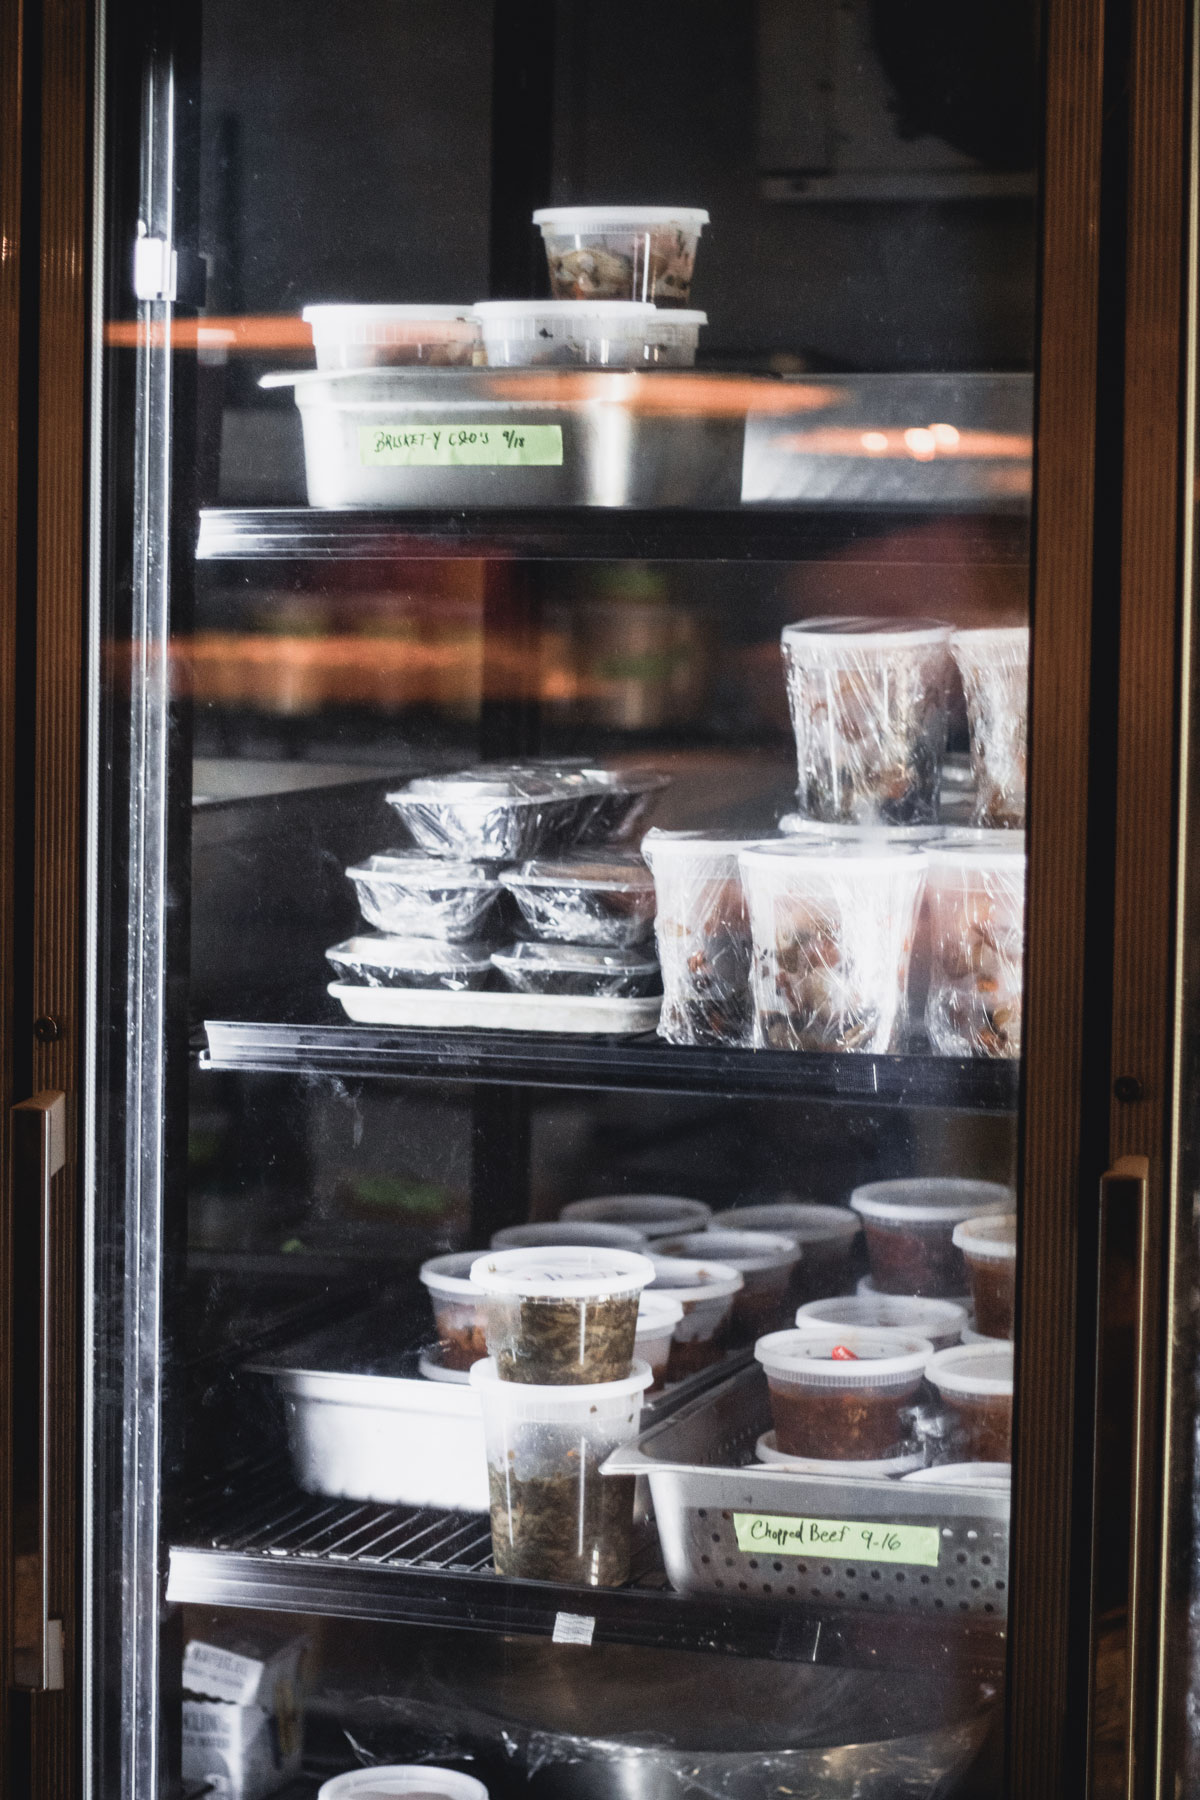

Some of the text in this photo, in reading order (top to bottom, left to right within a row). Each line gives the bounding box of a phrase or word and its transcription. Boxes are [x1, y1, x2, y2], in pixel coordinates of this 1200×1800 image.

[502, 429, 525, 449] 9/18
[750, 1520, 901, 1551] Chopped Beef 9-16
